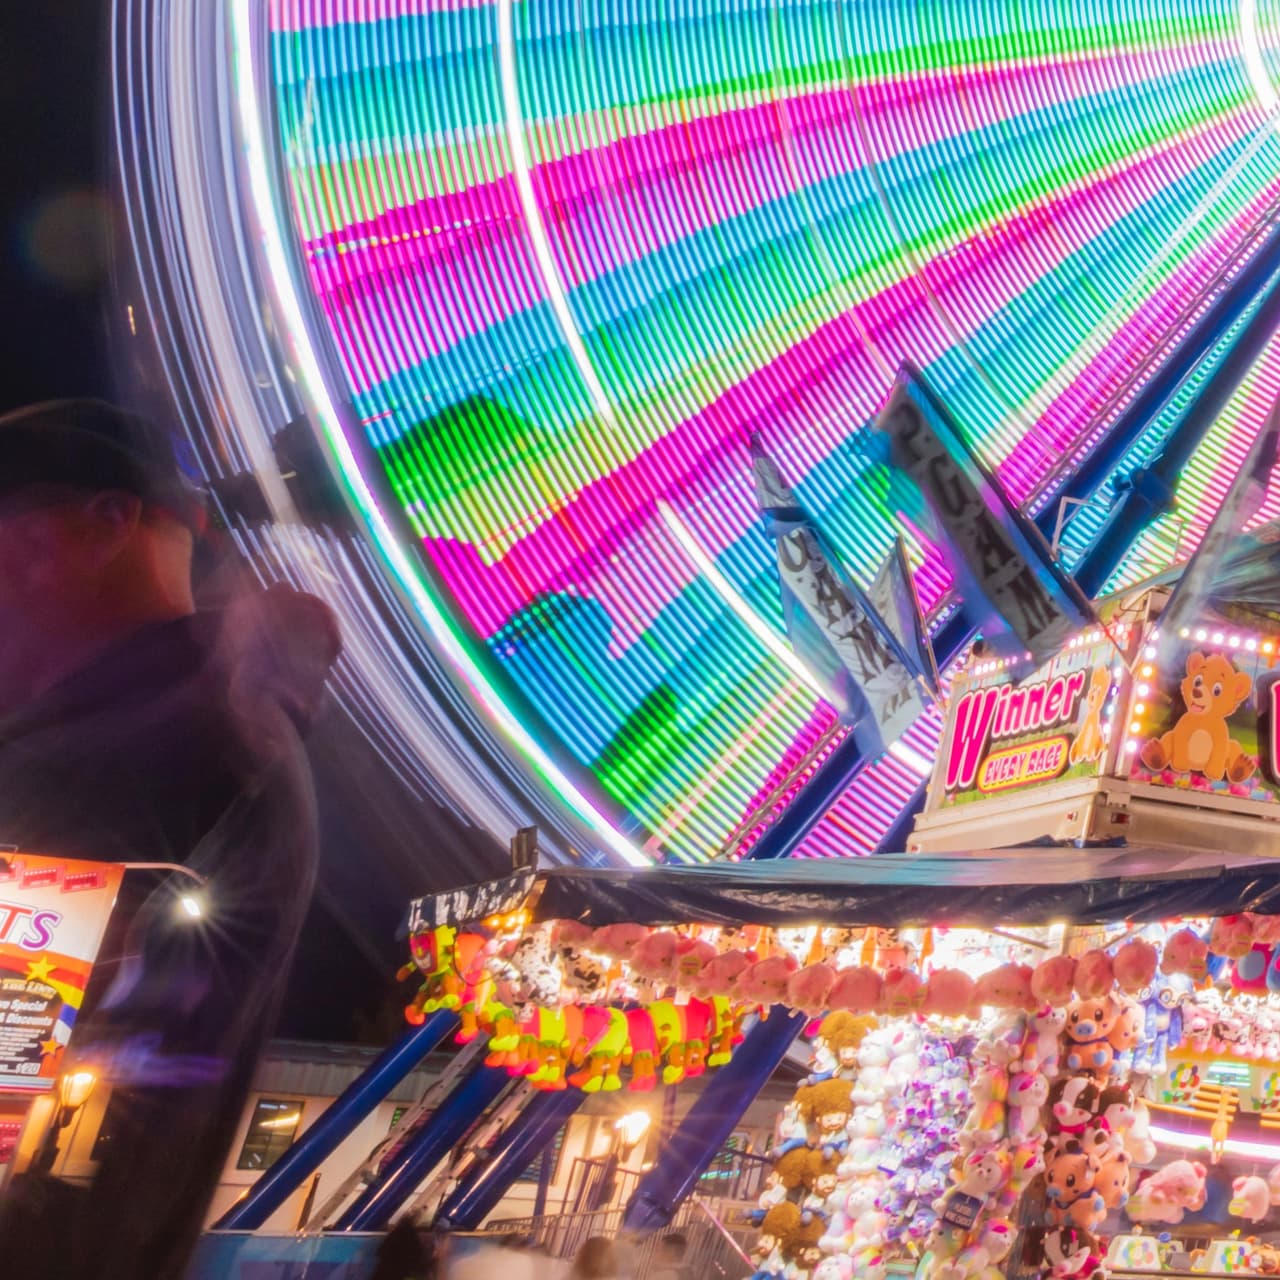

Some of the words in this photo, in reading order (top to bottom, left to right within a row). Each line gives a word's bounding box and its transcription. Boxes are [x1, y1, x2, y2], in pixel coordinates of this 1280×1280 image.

[945, 670, 1086, 791] Winner
[983, 752, 1028, 785] EVERY
[1026, 743, 1063, 775] RACE
